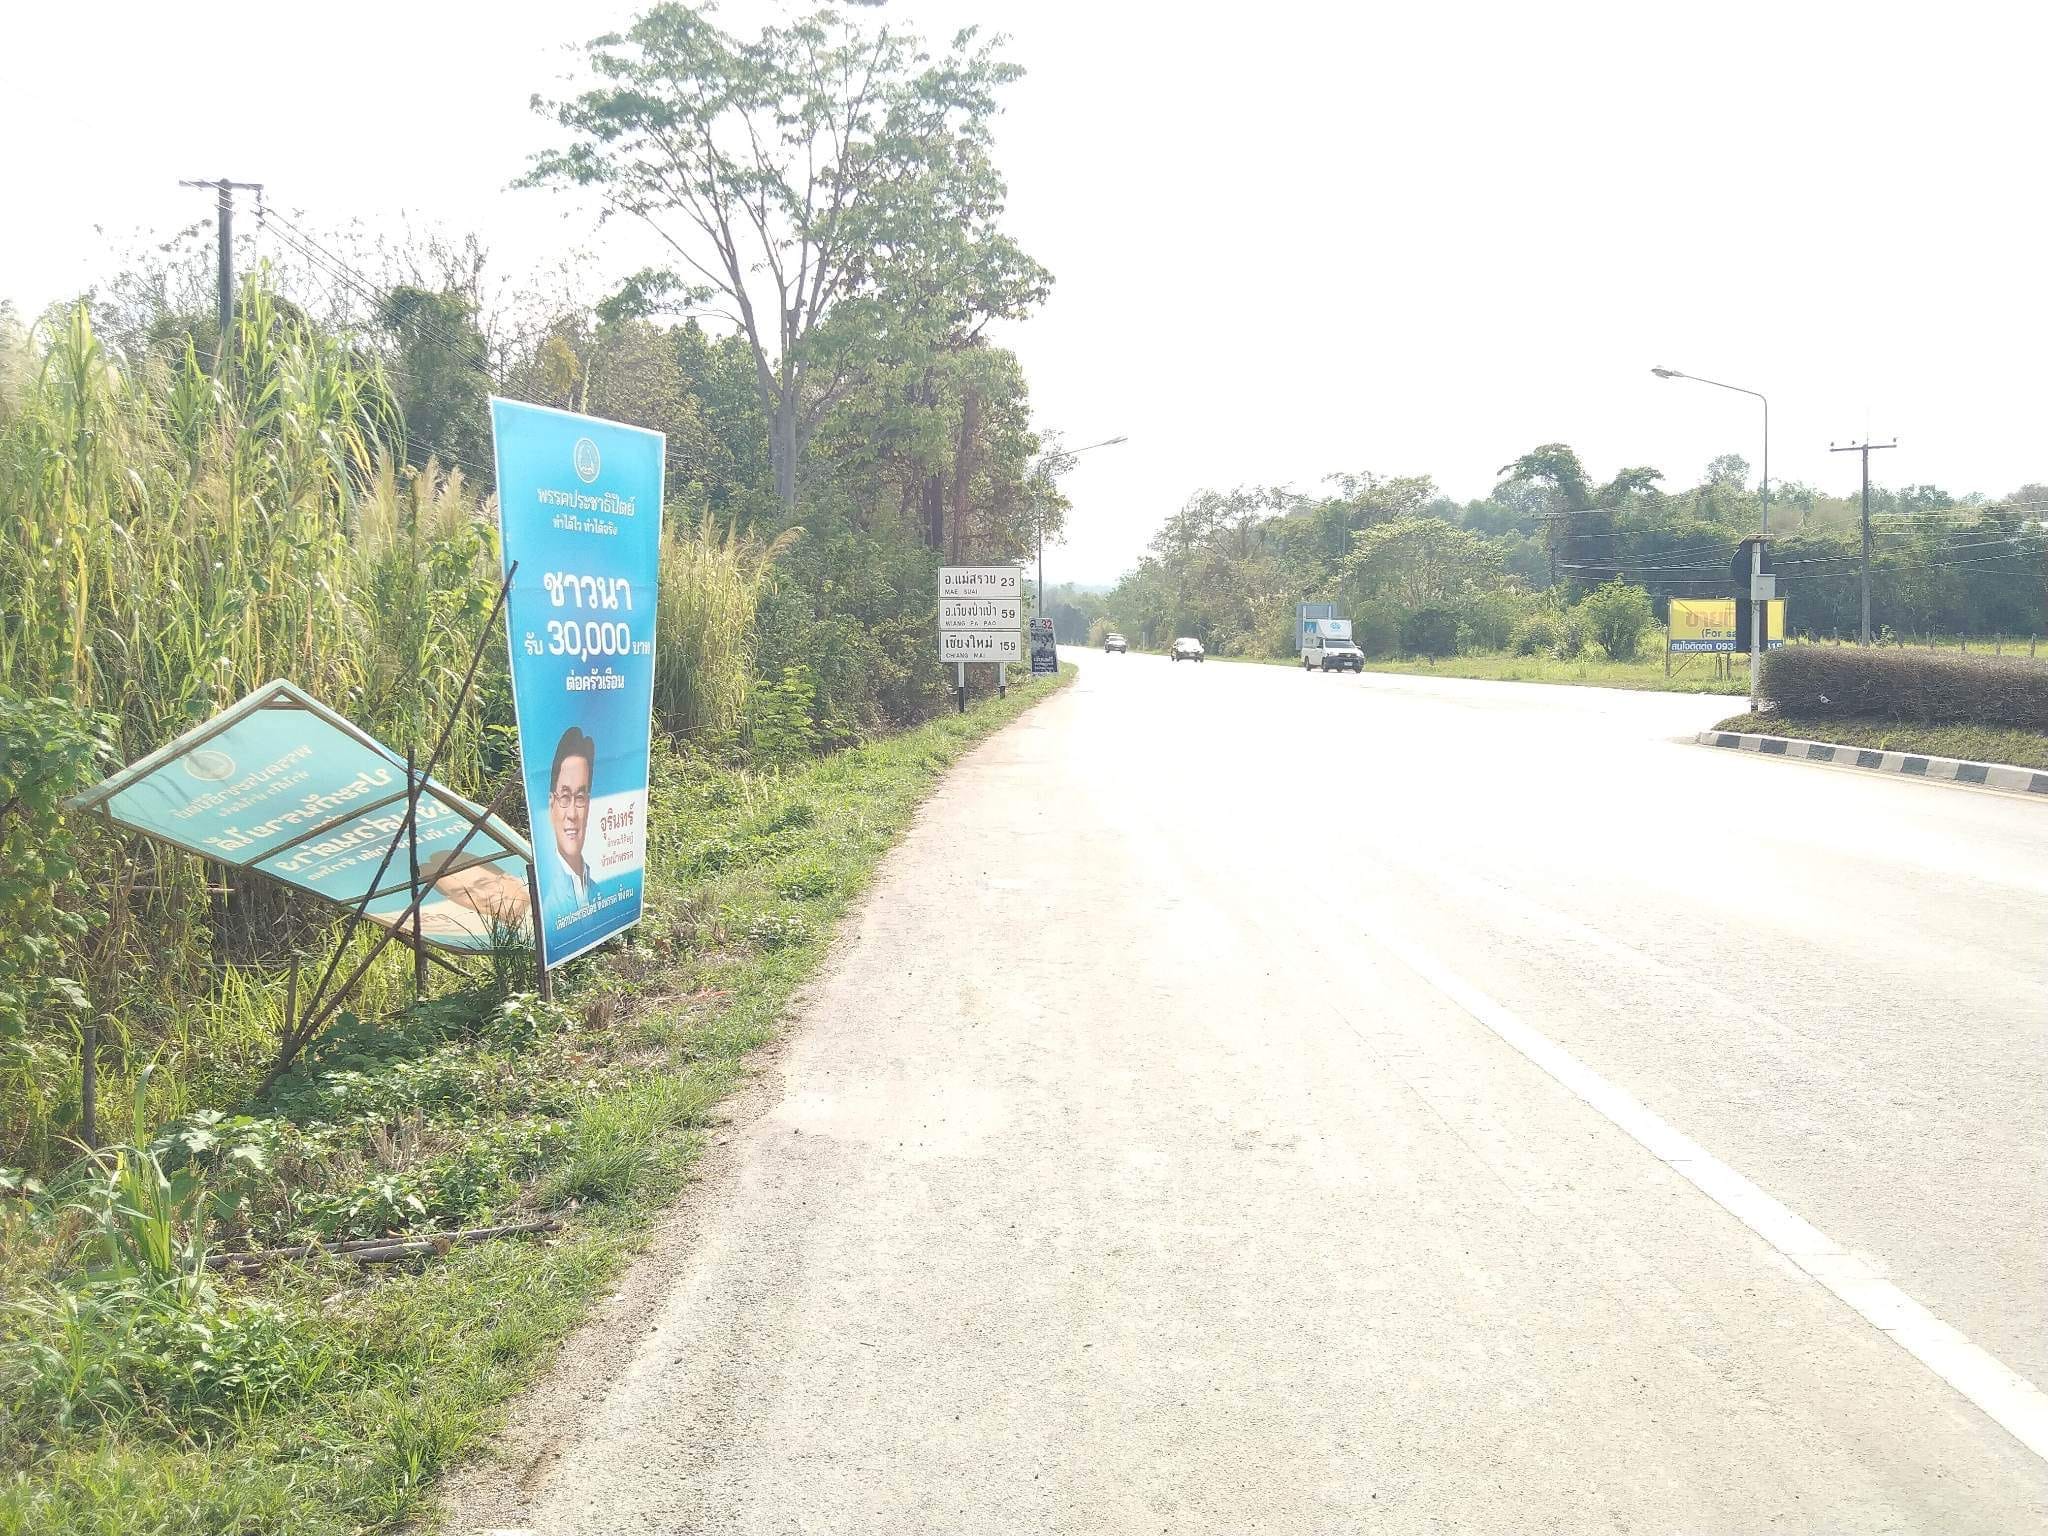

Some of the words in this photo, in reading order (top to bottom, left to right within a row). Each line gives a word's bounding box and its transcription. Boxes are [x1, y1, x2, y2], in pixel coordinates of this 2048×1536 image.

[537, 488, 635, 517] พรรคประชาธิปัตย์
[543, 570, 633, 611] ชาวนา
[1000, 577, 1015, 587] 23
[1001, 609, 1016, 619] 59
[524, 631, 545, 656] รับ
[547, 619, 631, 663] 30,000
[632, 641, 651, 656] บาท
[945, 635, 993, 649] เชียงใหม่
[1000, 641, 1016, 651] 159
[1701, 629, 1721, 638] (For
[566, 667, 625, 691] ต่อครัวเรือน
[600, 801, 635, 840] จุรินทร์
